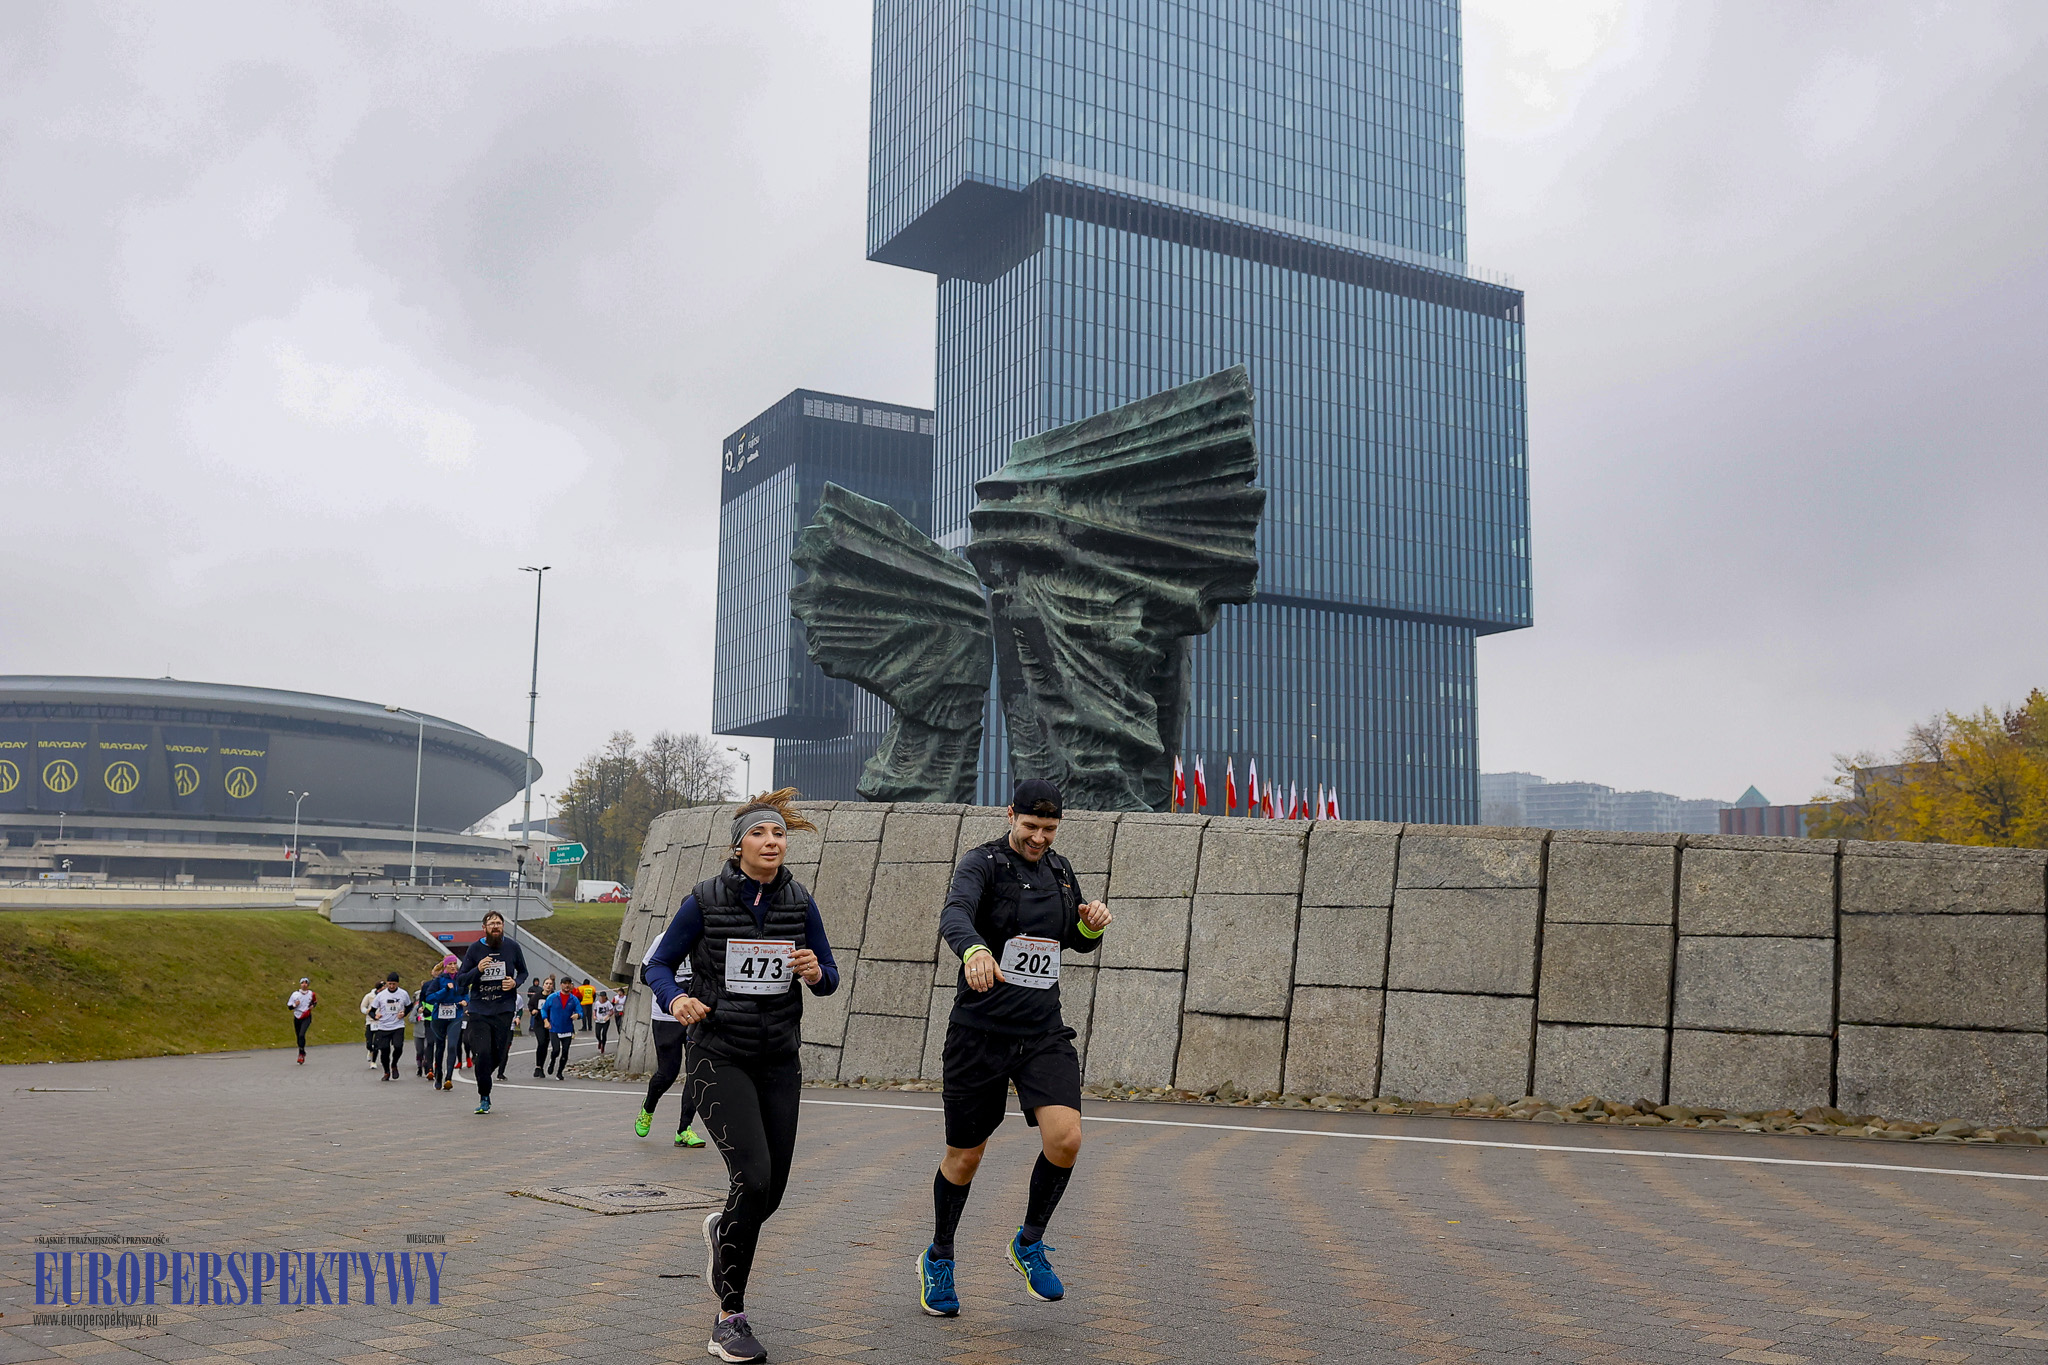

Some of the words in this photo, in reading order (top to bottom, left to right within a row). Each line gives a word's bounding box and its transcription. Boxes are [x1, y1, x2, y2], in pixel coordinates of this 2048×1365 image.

[100, 742, 148, 751] MAYDAY
[220, 747, 265, 757] MAYDAY
[740, 957, 783, 979] 473
[1014, 952, 1050, 975] 202
[485, 968, 501, 976] 379
